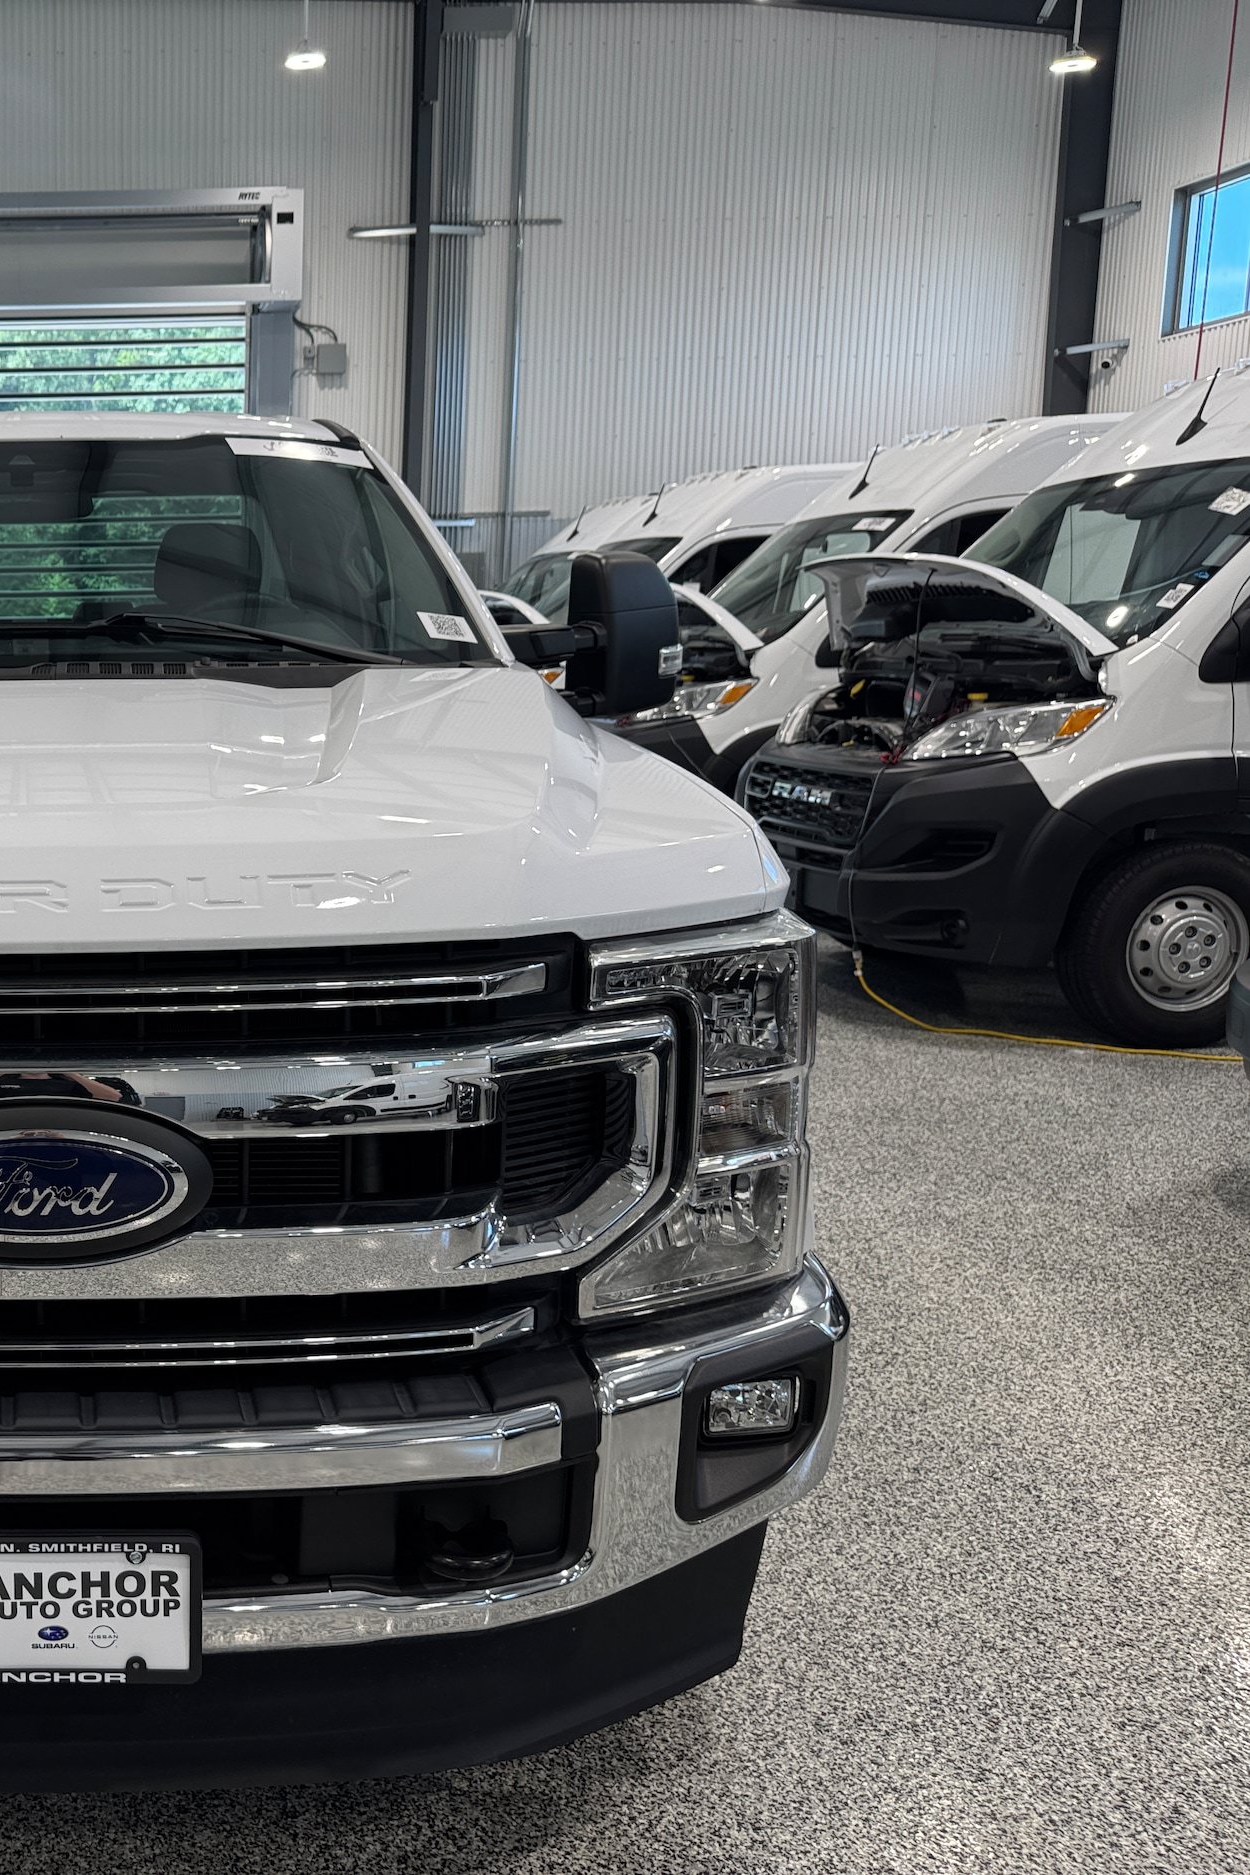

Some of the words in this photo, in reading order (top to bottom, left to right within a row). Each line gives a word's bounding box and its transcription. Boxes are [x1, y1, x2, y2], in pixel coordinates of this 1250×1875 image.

[100, 868, 412, 912] DUTY
[0, 1543, 21, 1553] N.
[161, 1543, 181, 1553] RI
[72, 1598, 181, 1618] GROUP
